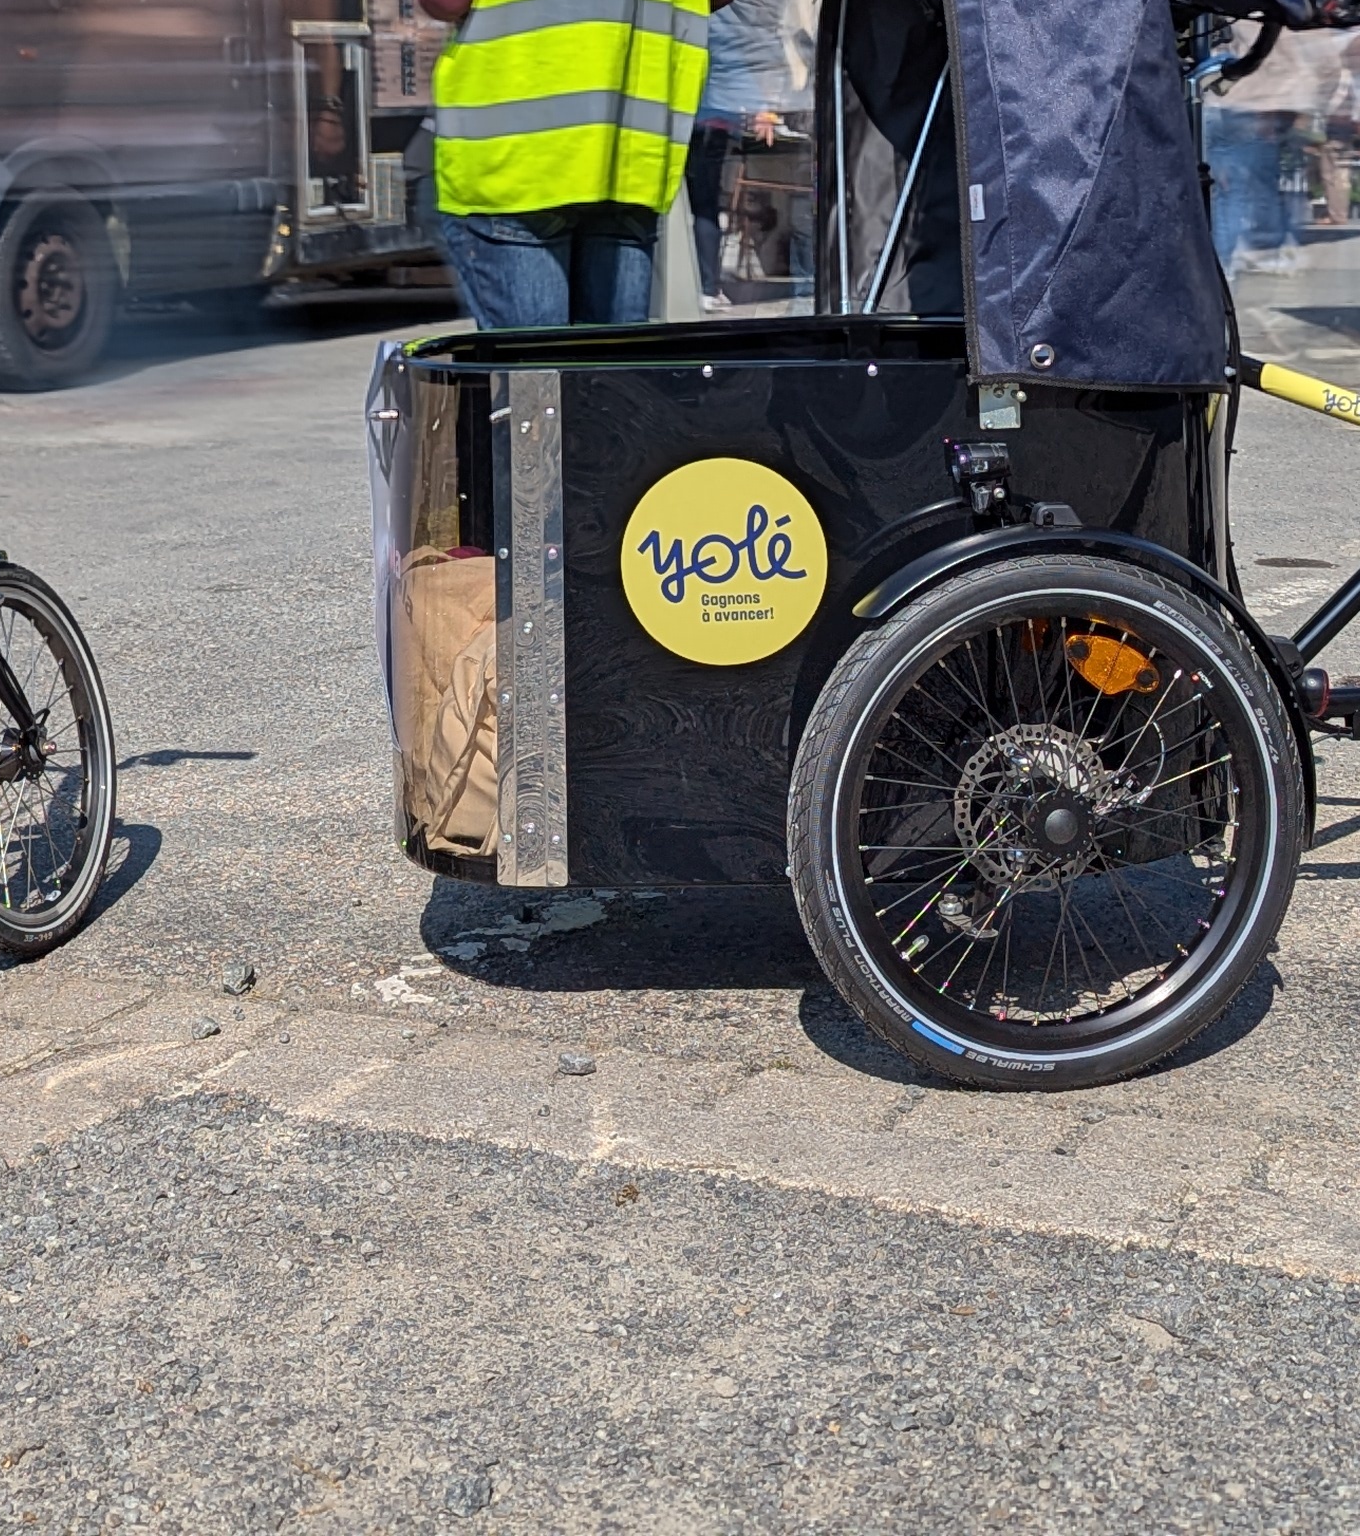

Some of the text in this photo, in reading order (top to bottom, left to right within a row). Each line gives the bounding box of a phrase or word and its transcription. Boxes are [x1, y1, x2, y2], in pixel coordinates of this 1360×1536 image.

[637, 504, 808, 604] yolé
[701, 593, 761, 609] Gagnons
[702, 607, 775, 623] à avancer!
[1254, 707, 1280, 765] 47-406
[831, 906, 1056, 1072] SCHWALBE MARATHON PLUS
